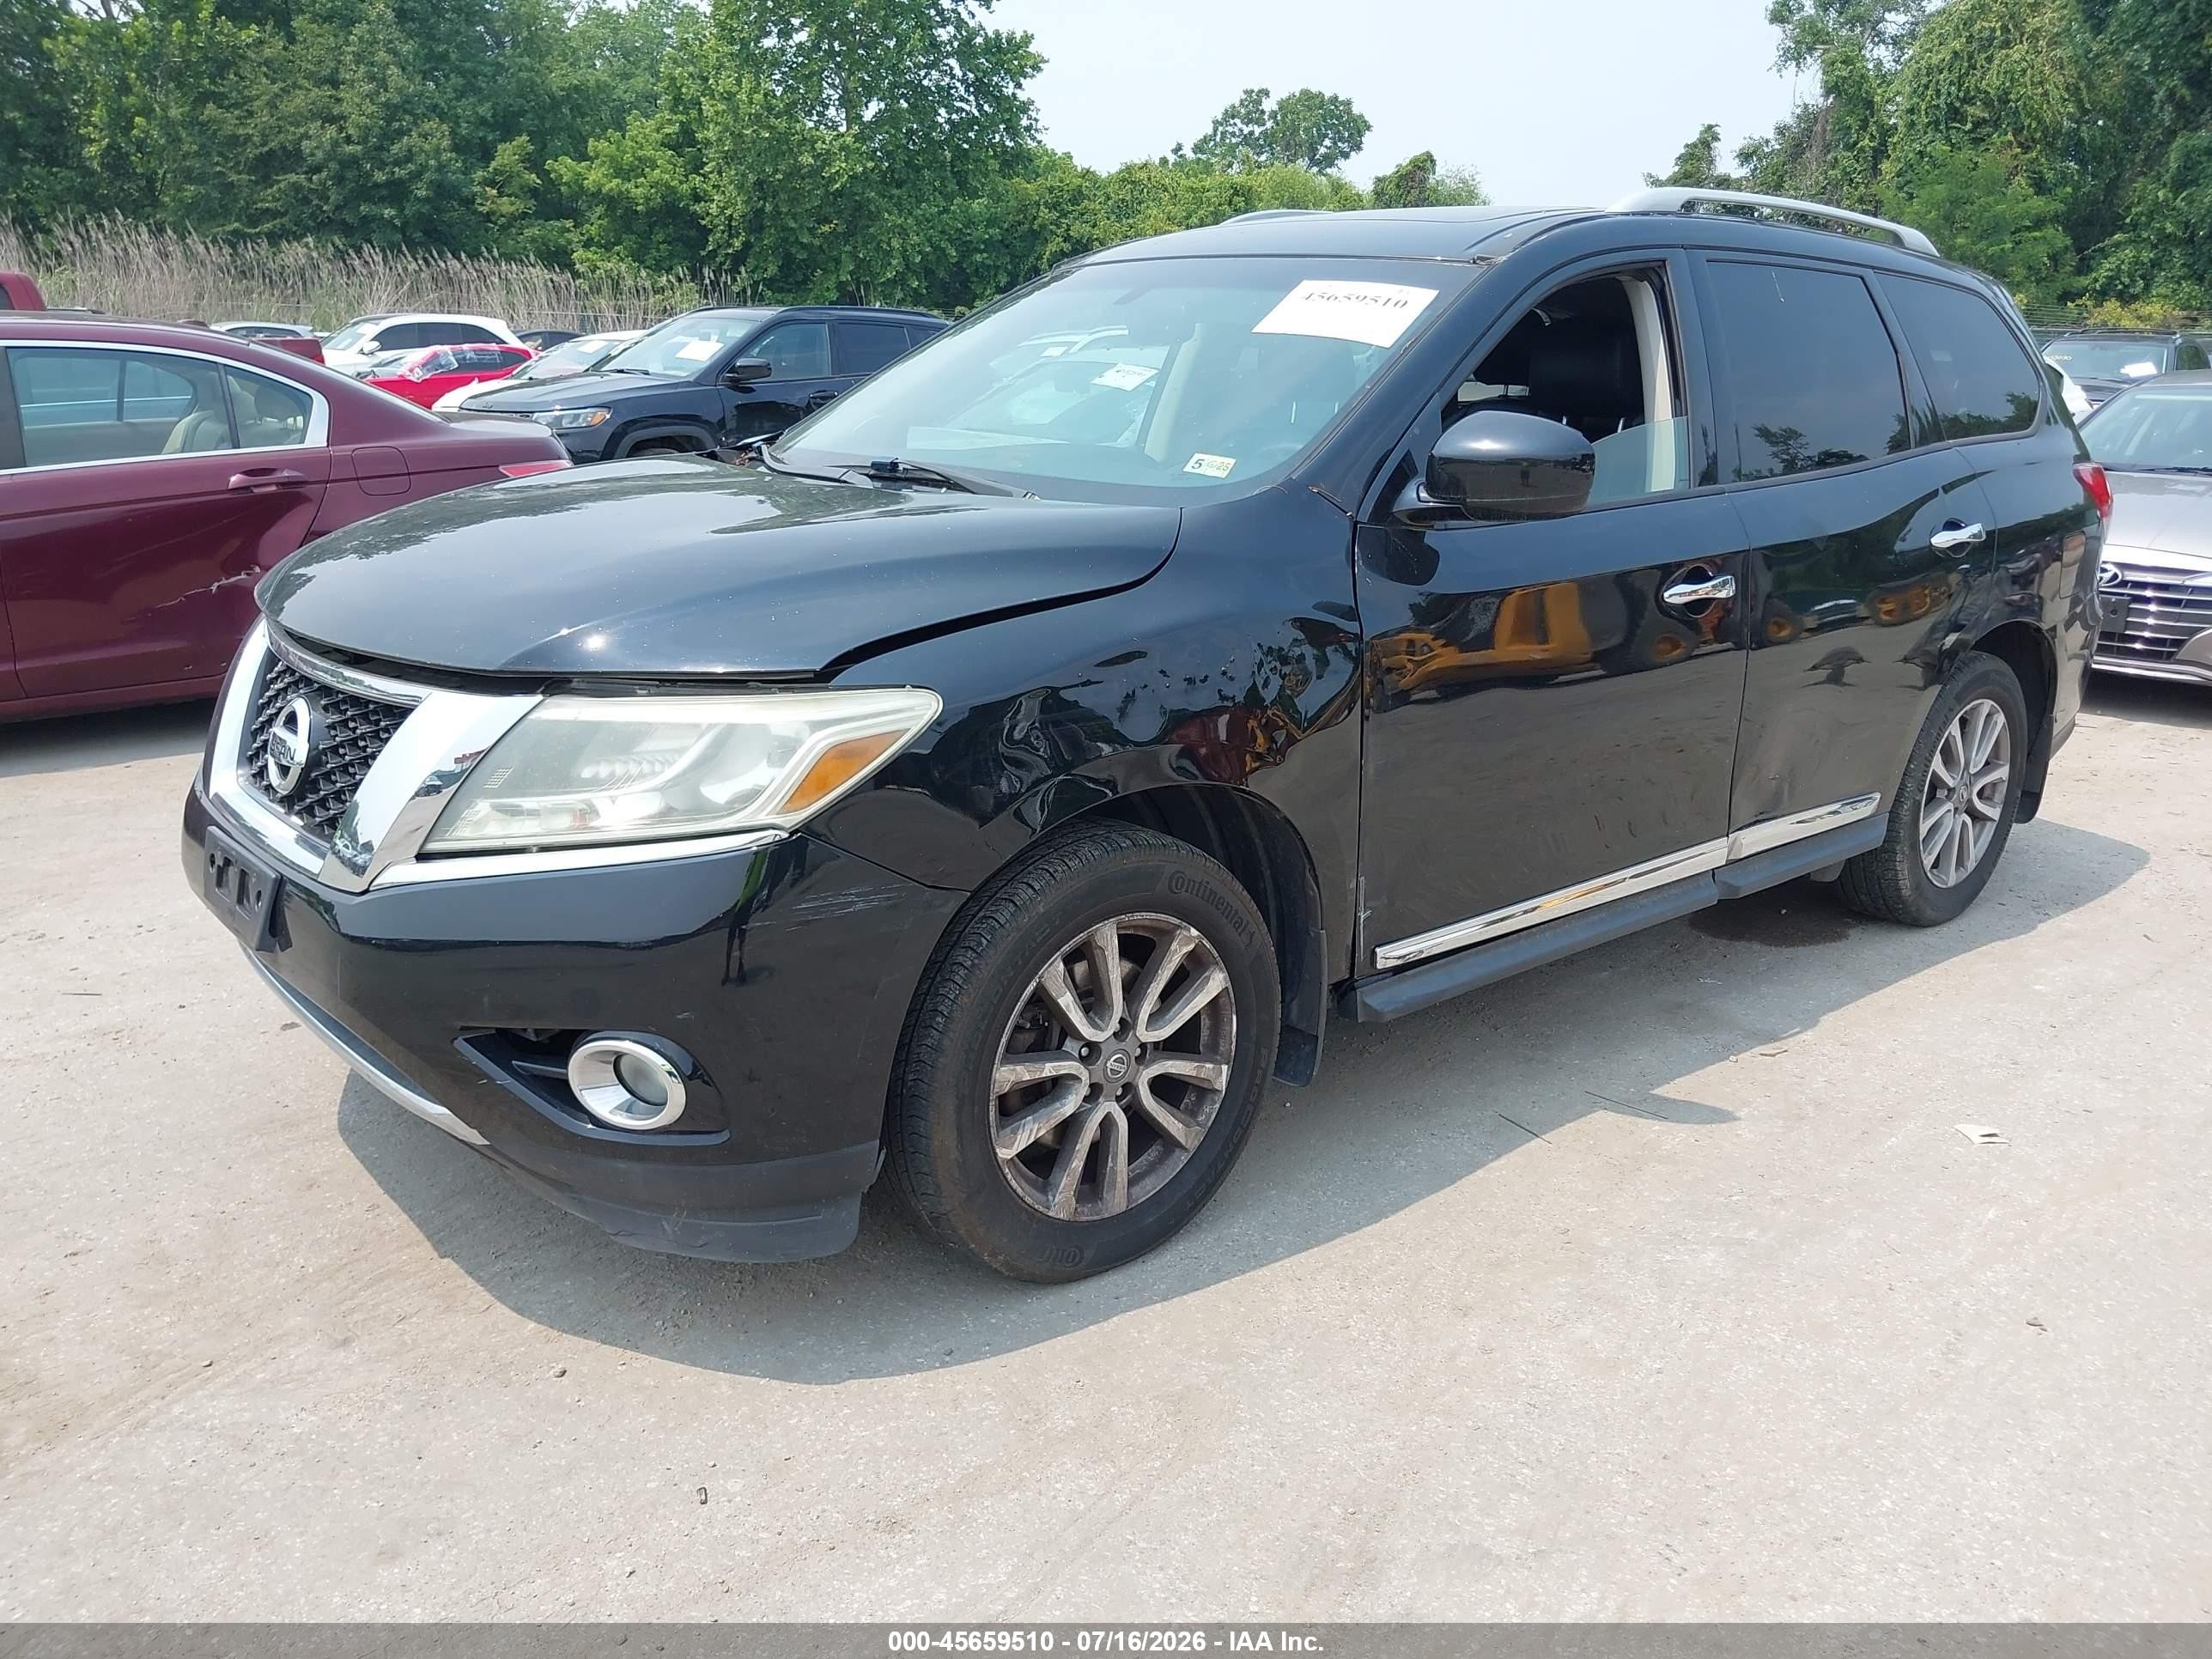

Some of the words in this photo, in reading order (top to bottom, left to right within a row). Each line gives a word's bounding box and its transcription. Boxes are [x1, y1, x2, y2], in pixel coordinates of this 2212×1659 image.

[1191, 459, 1206, 470] 5
[1216, 461, 1231, 471] 25
[1168, 871, 1250, 938] Continental
